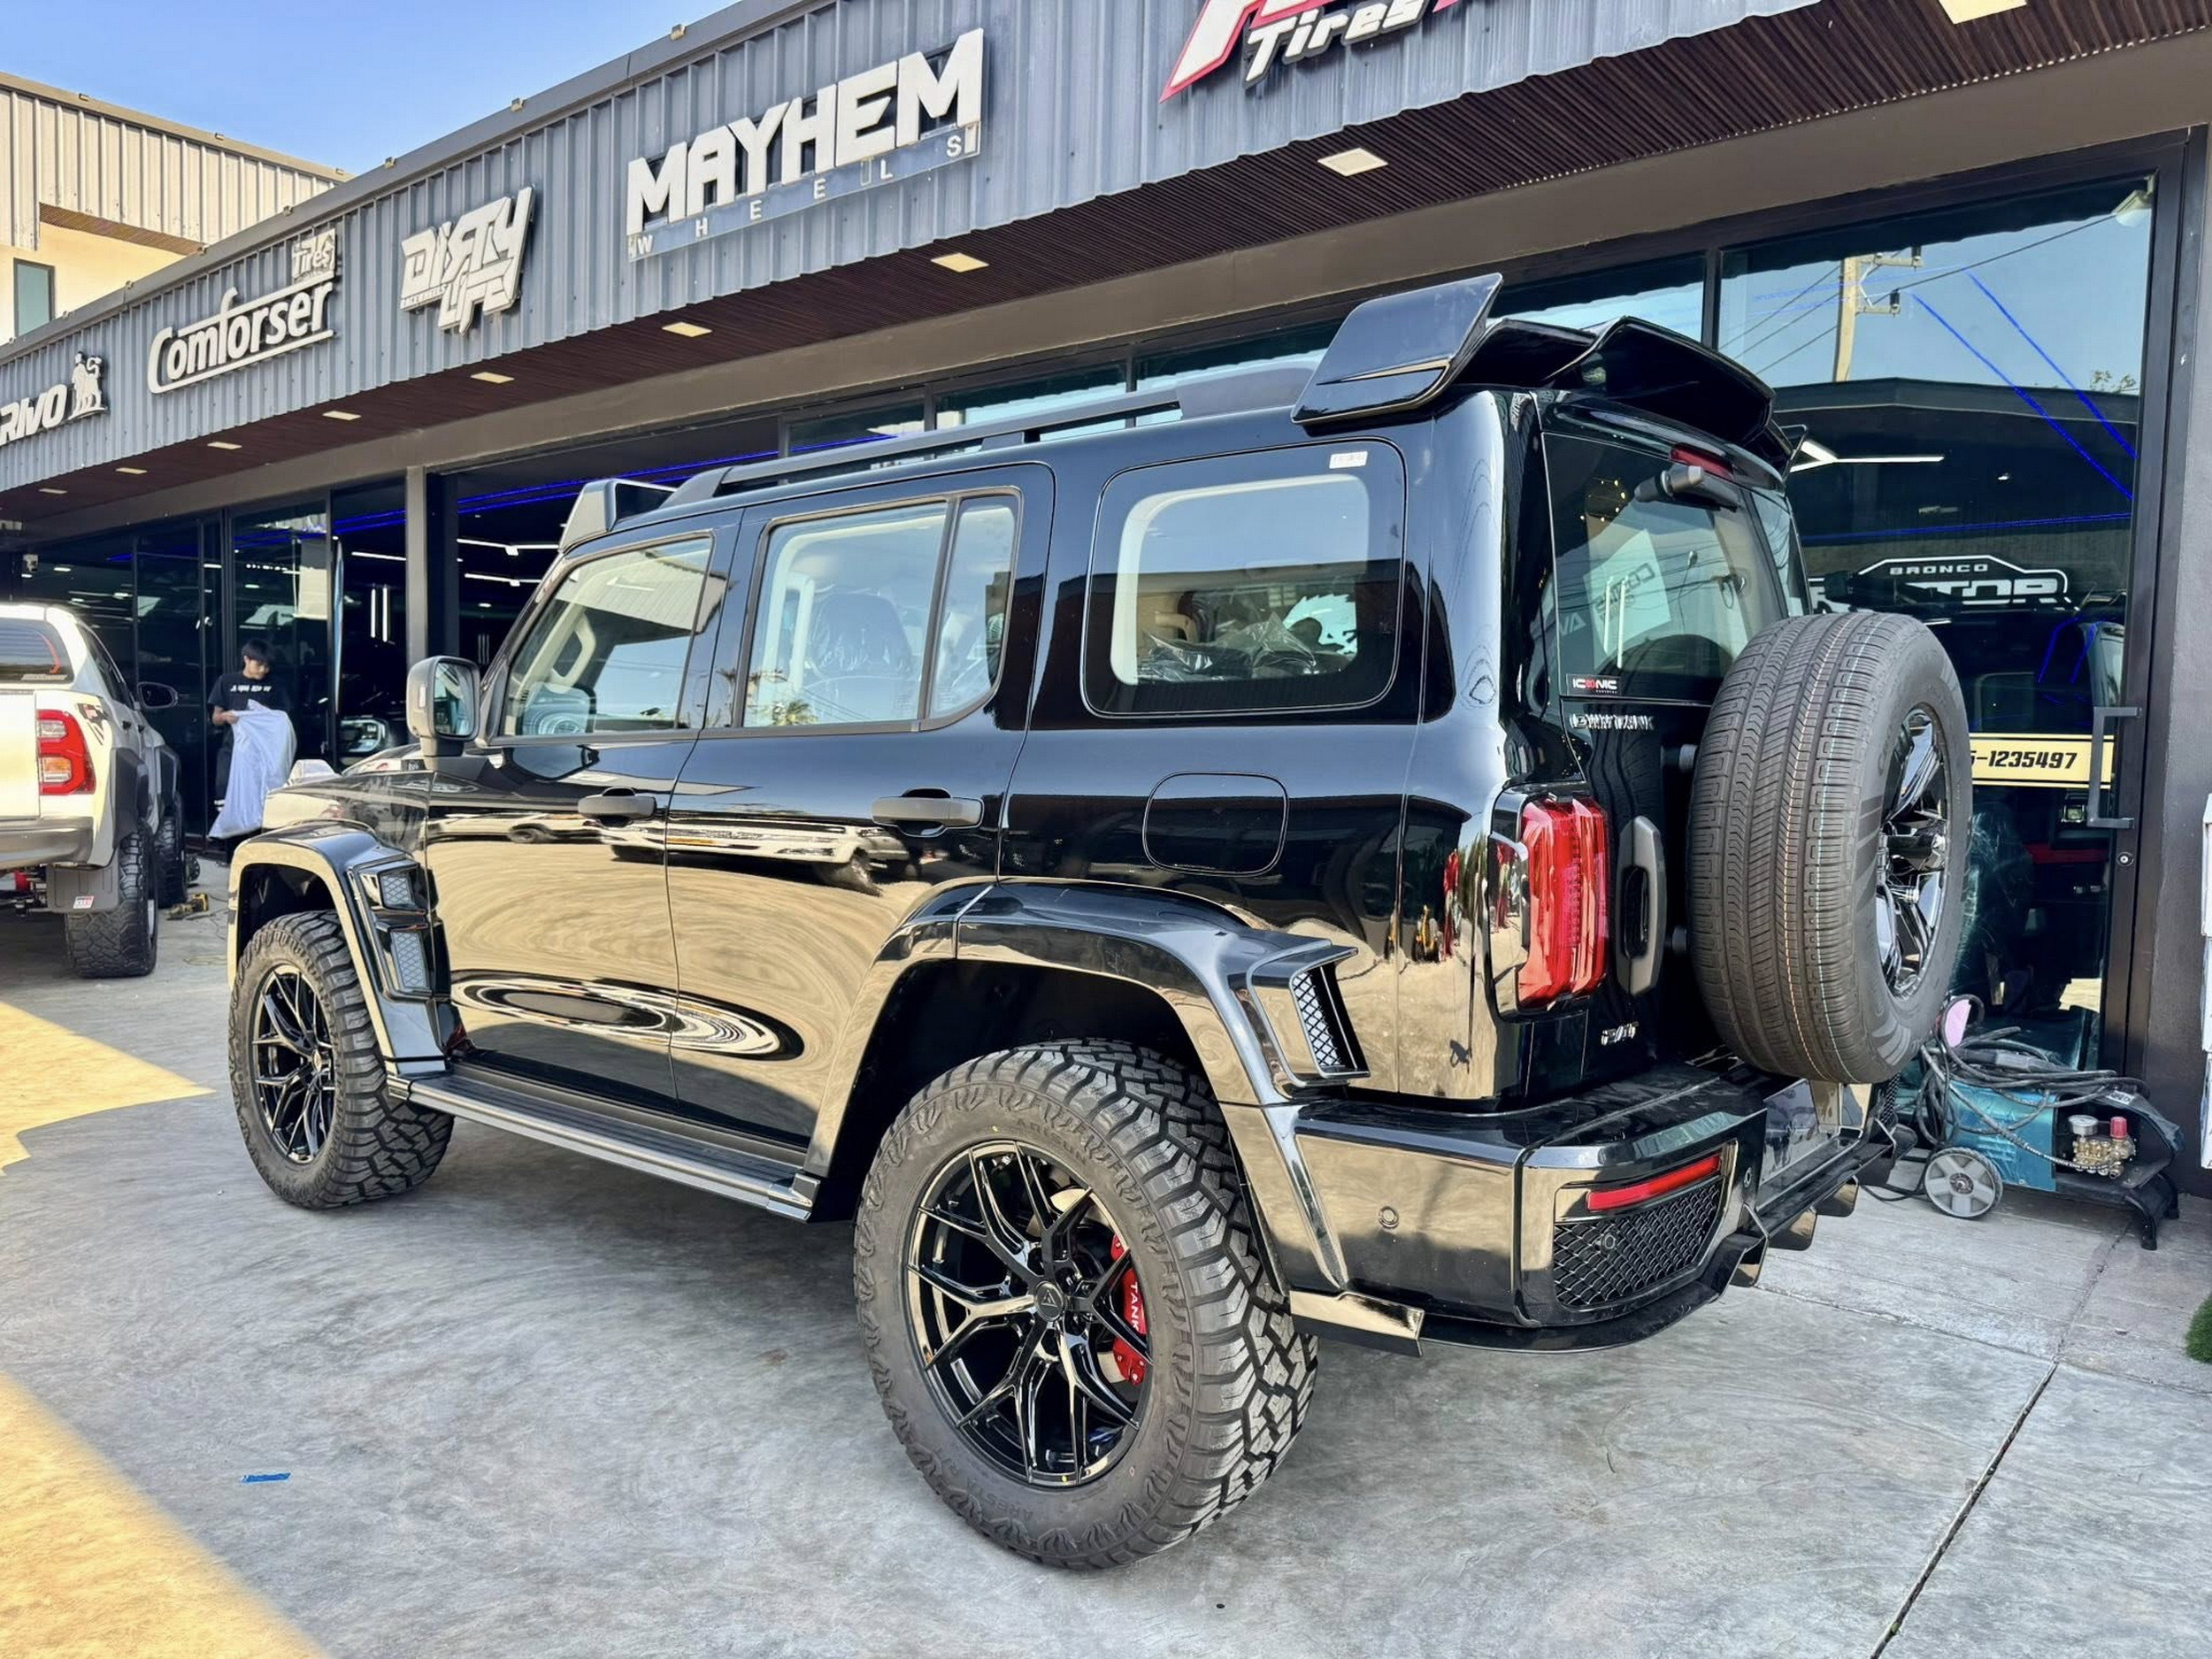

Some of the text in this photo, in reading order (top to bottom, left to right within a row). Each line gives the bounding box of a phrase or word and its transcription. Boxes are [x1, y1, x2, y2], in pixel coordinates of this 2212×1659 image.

[1243, 0, 1426, 86] Tires
[626, 27, 984, 236] MAYHEM
[401, 187, 533, 305] DIRTY
[148, 287, 334, 394] Comforser
[1890, 564, 1988, 575] BRONCO
[1130, 1281, 1140, 1331] TANK
